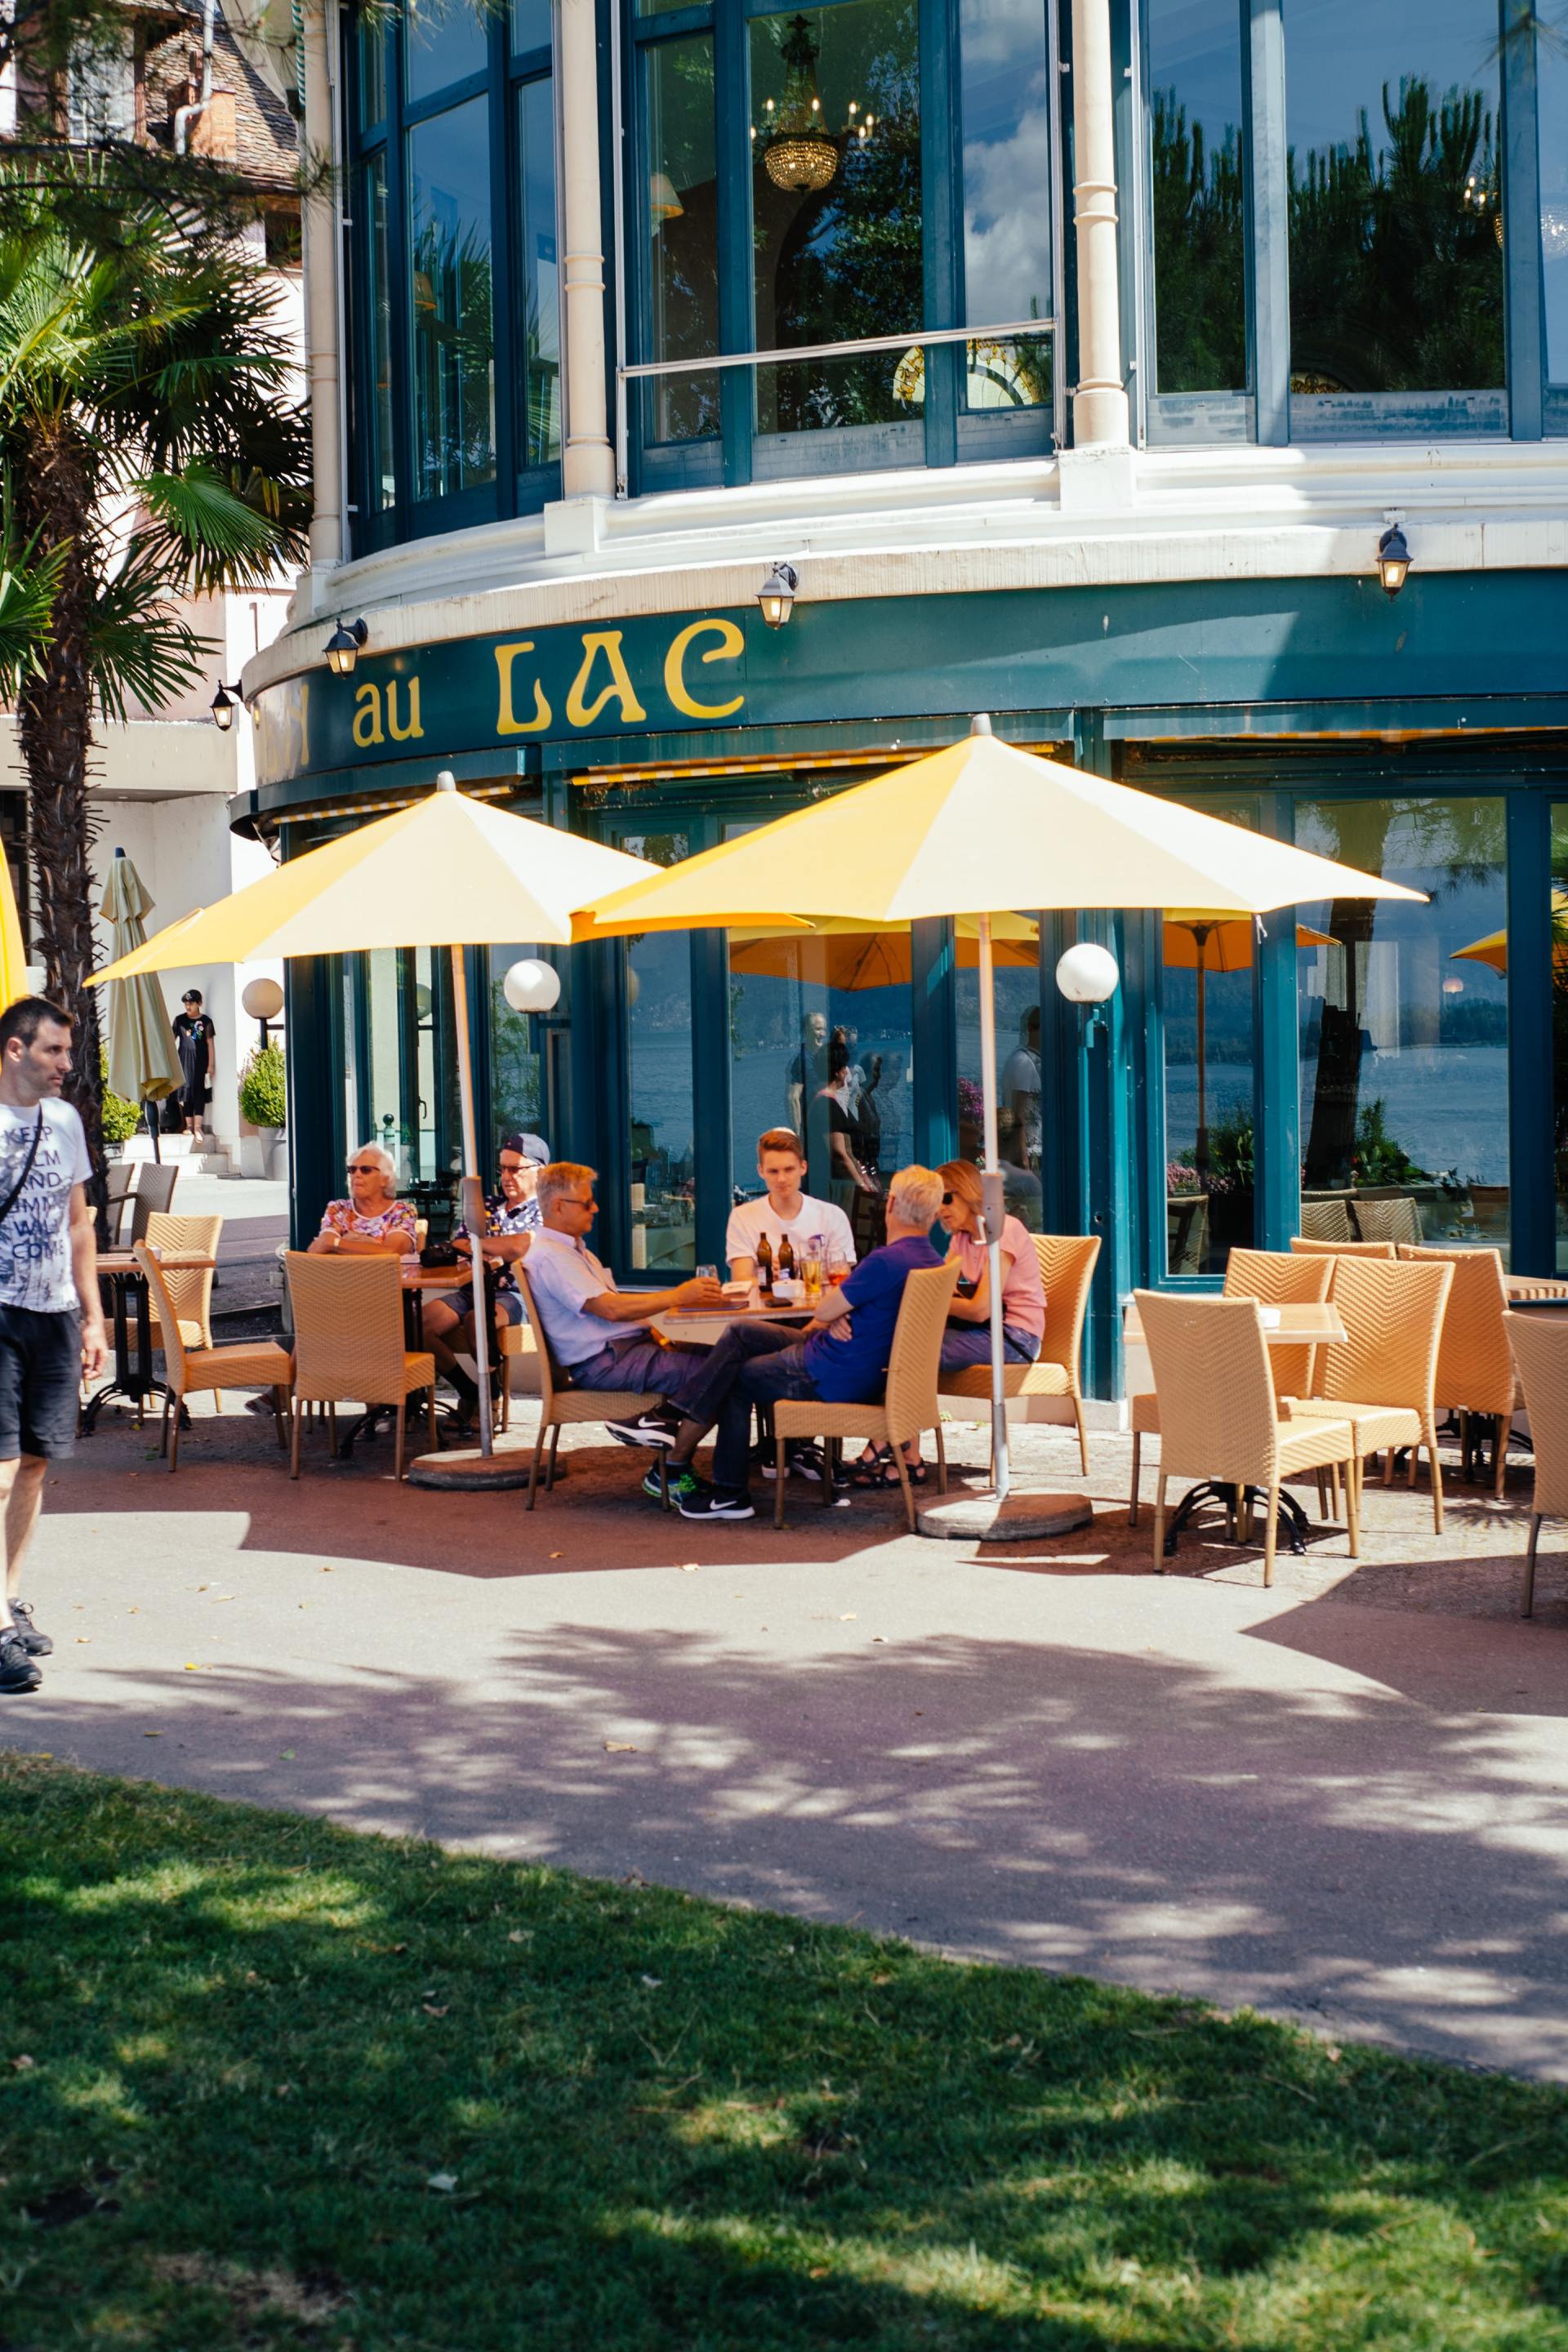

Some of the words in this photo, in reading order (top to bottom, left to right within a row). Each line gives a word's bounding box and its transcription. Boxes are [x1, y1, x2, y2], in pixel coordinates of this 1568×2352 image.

[353, 675, 425, 748] au
[494, 618, 745, 736] LAC
[22, 1171, 63, 1191] ND
